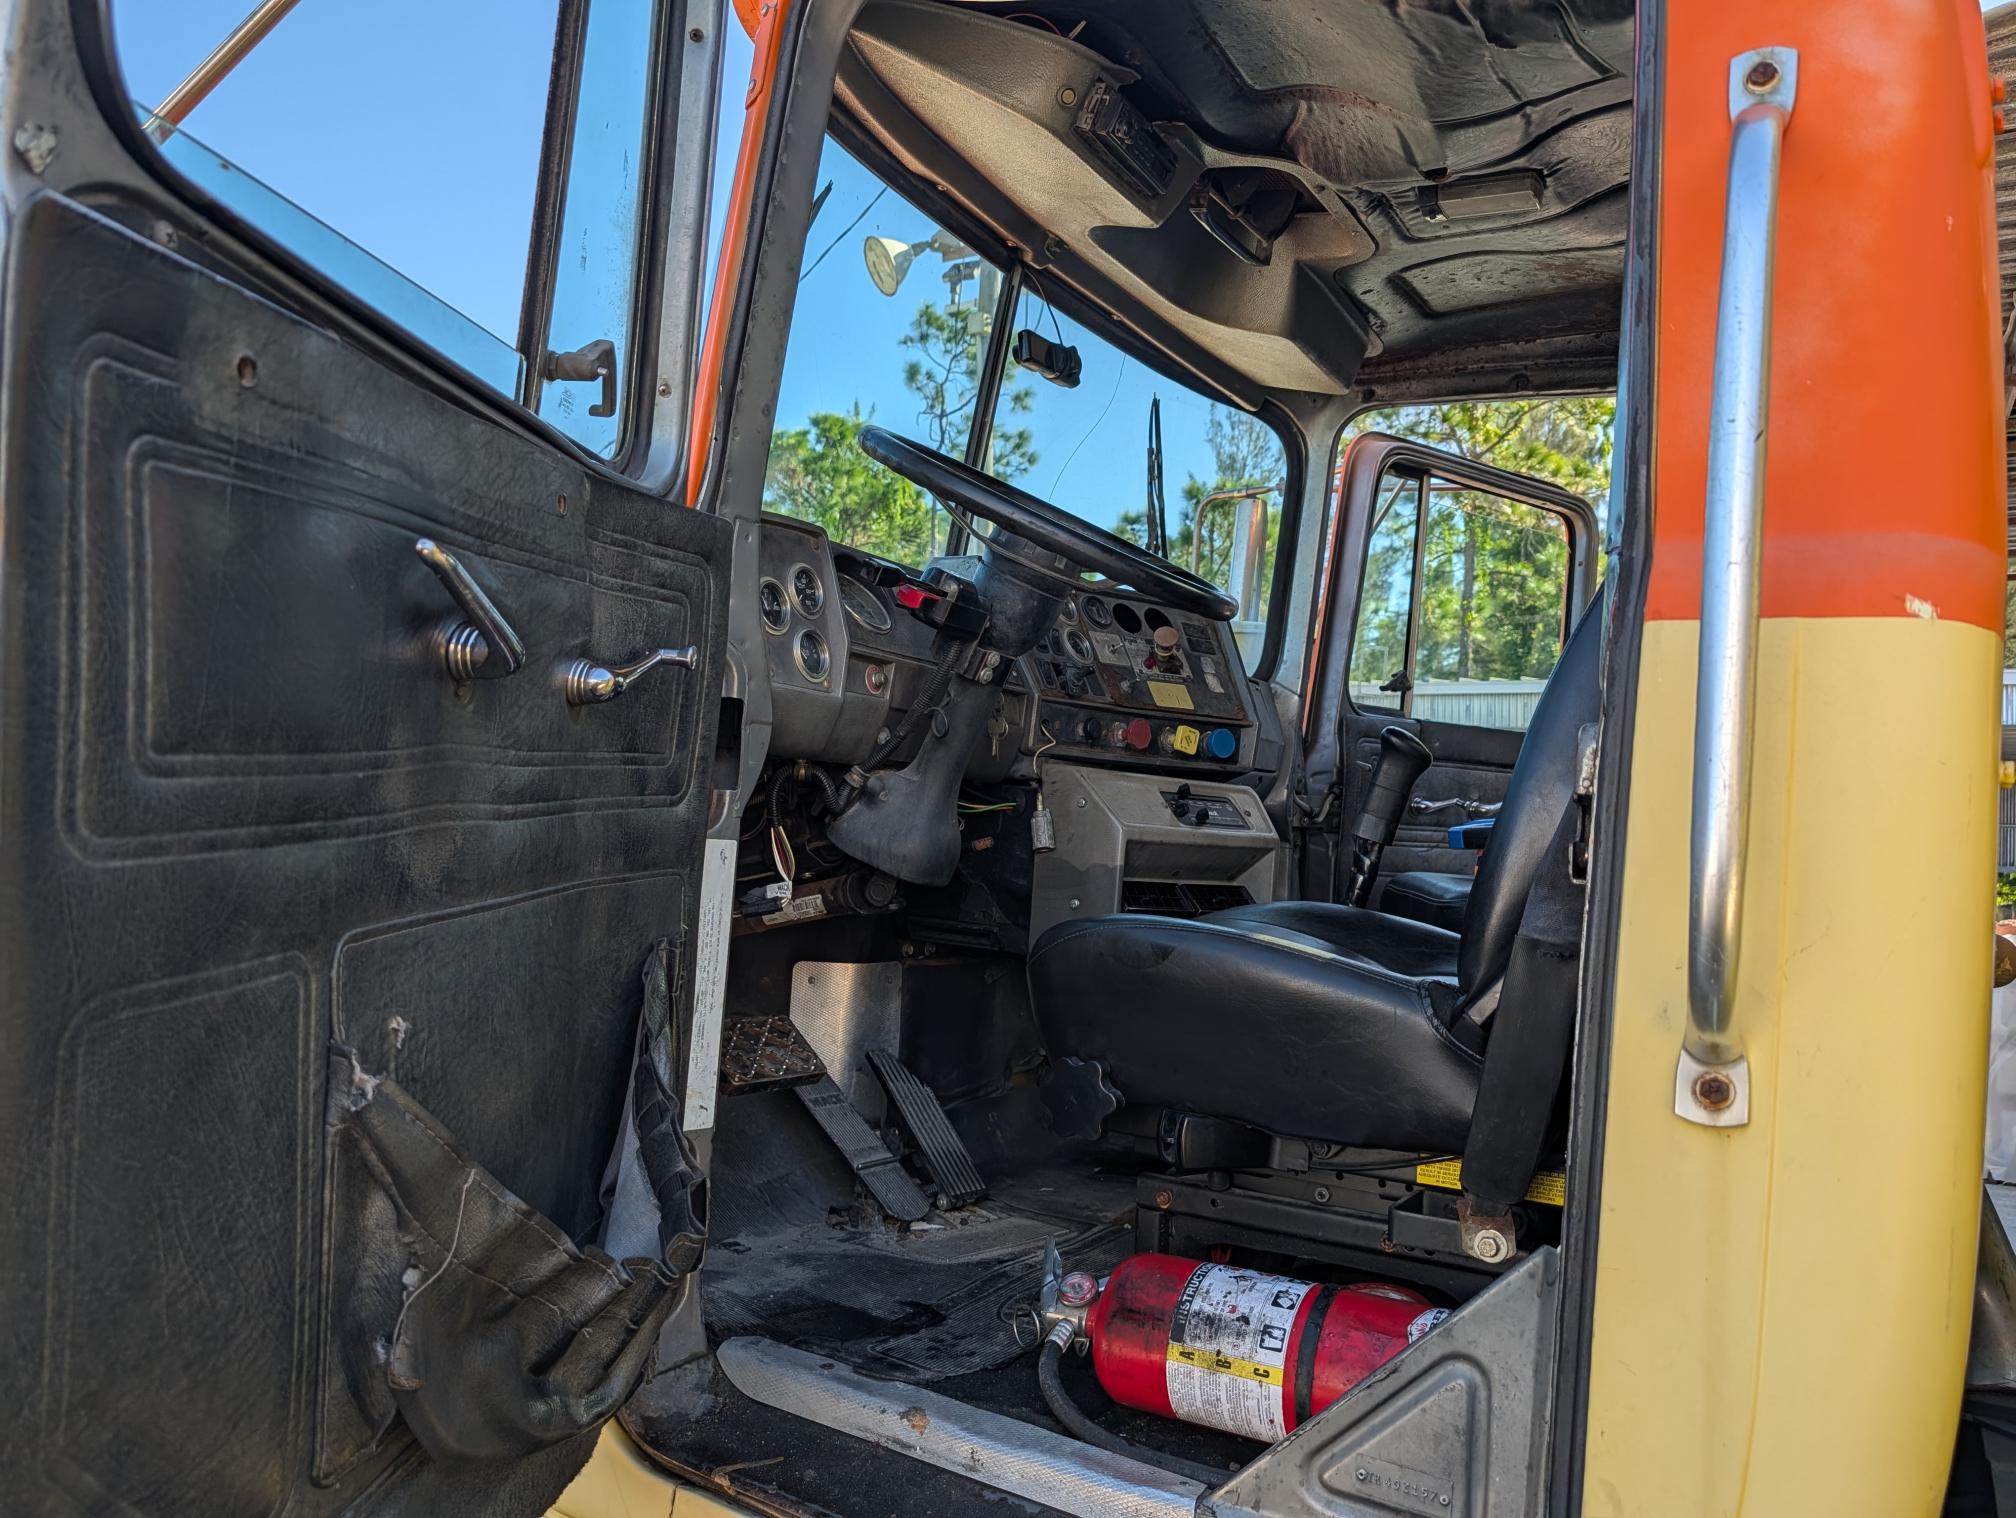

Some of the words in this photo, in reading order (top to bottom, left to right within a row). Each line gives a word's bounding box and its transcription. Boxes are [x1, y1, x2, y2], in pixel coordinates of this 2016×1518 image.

[1179, 1350, 1195, 1362] A
[1216, 1358, 1232, 1370] B
[1253, 1367, 1270, 1379] C
